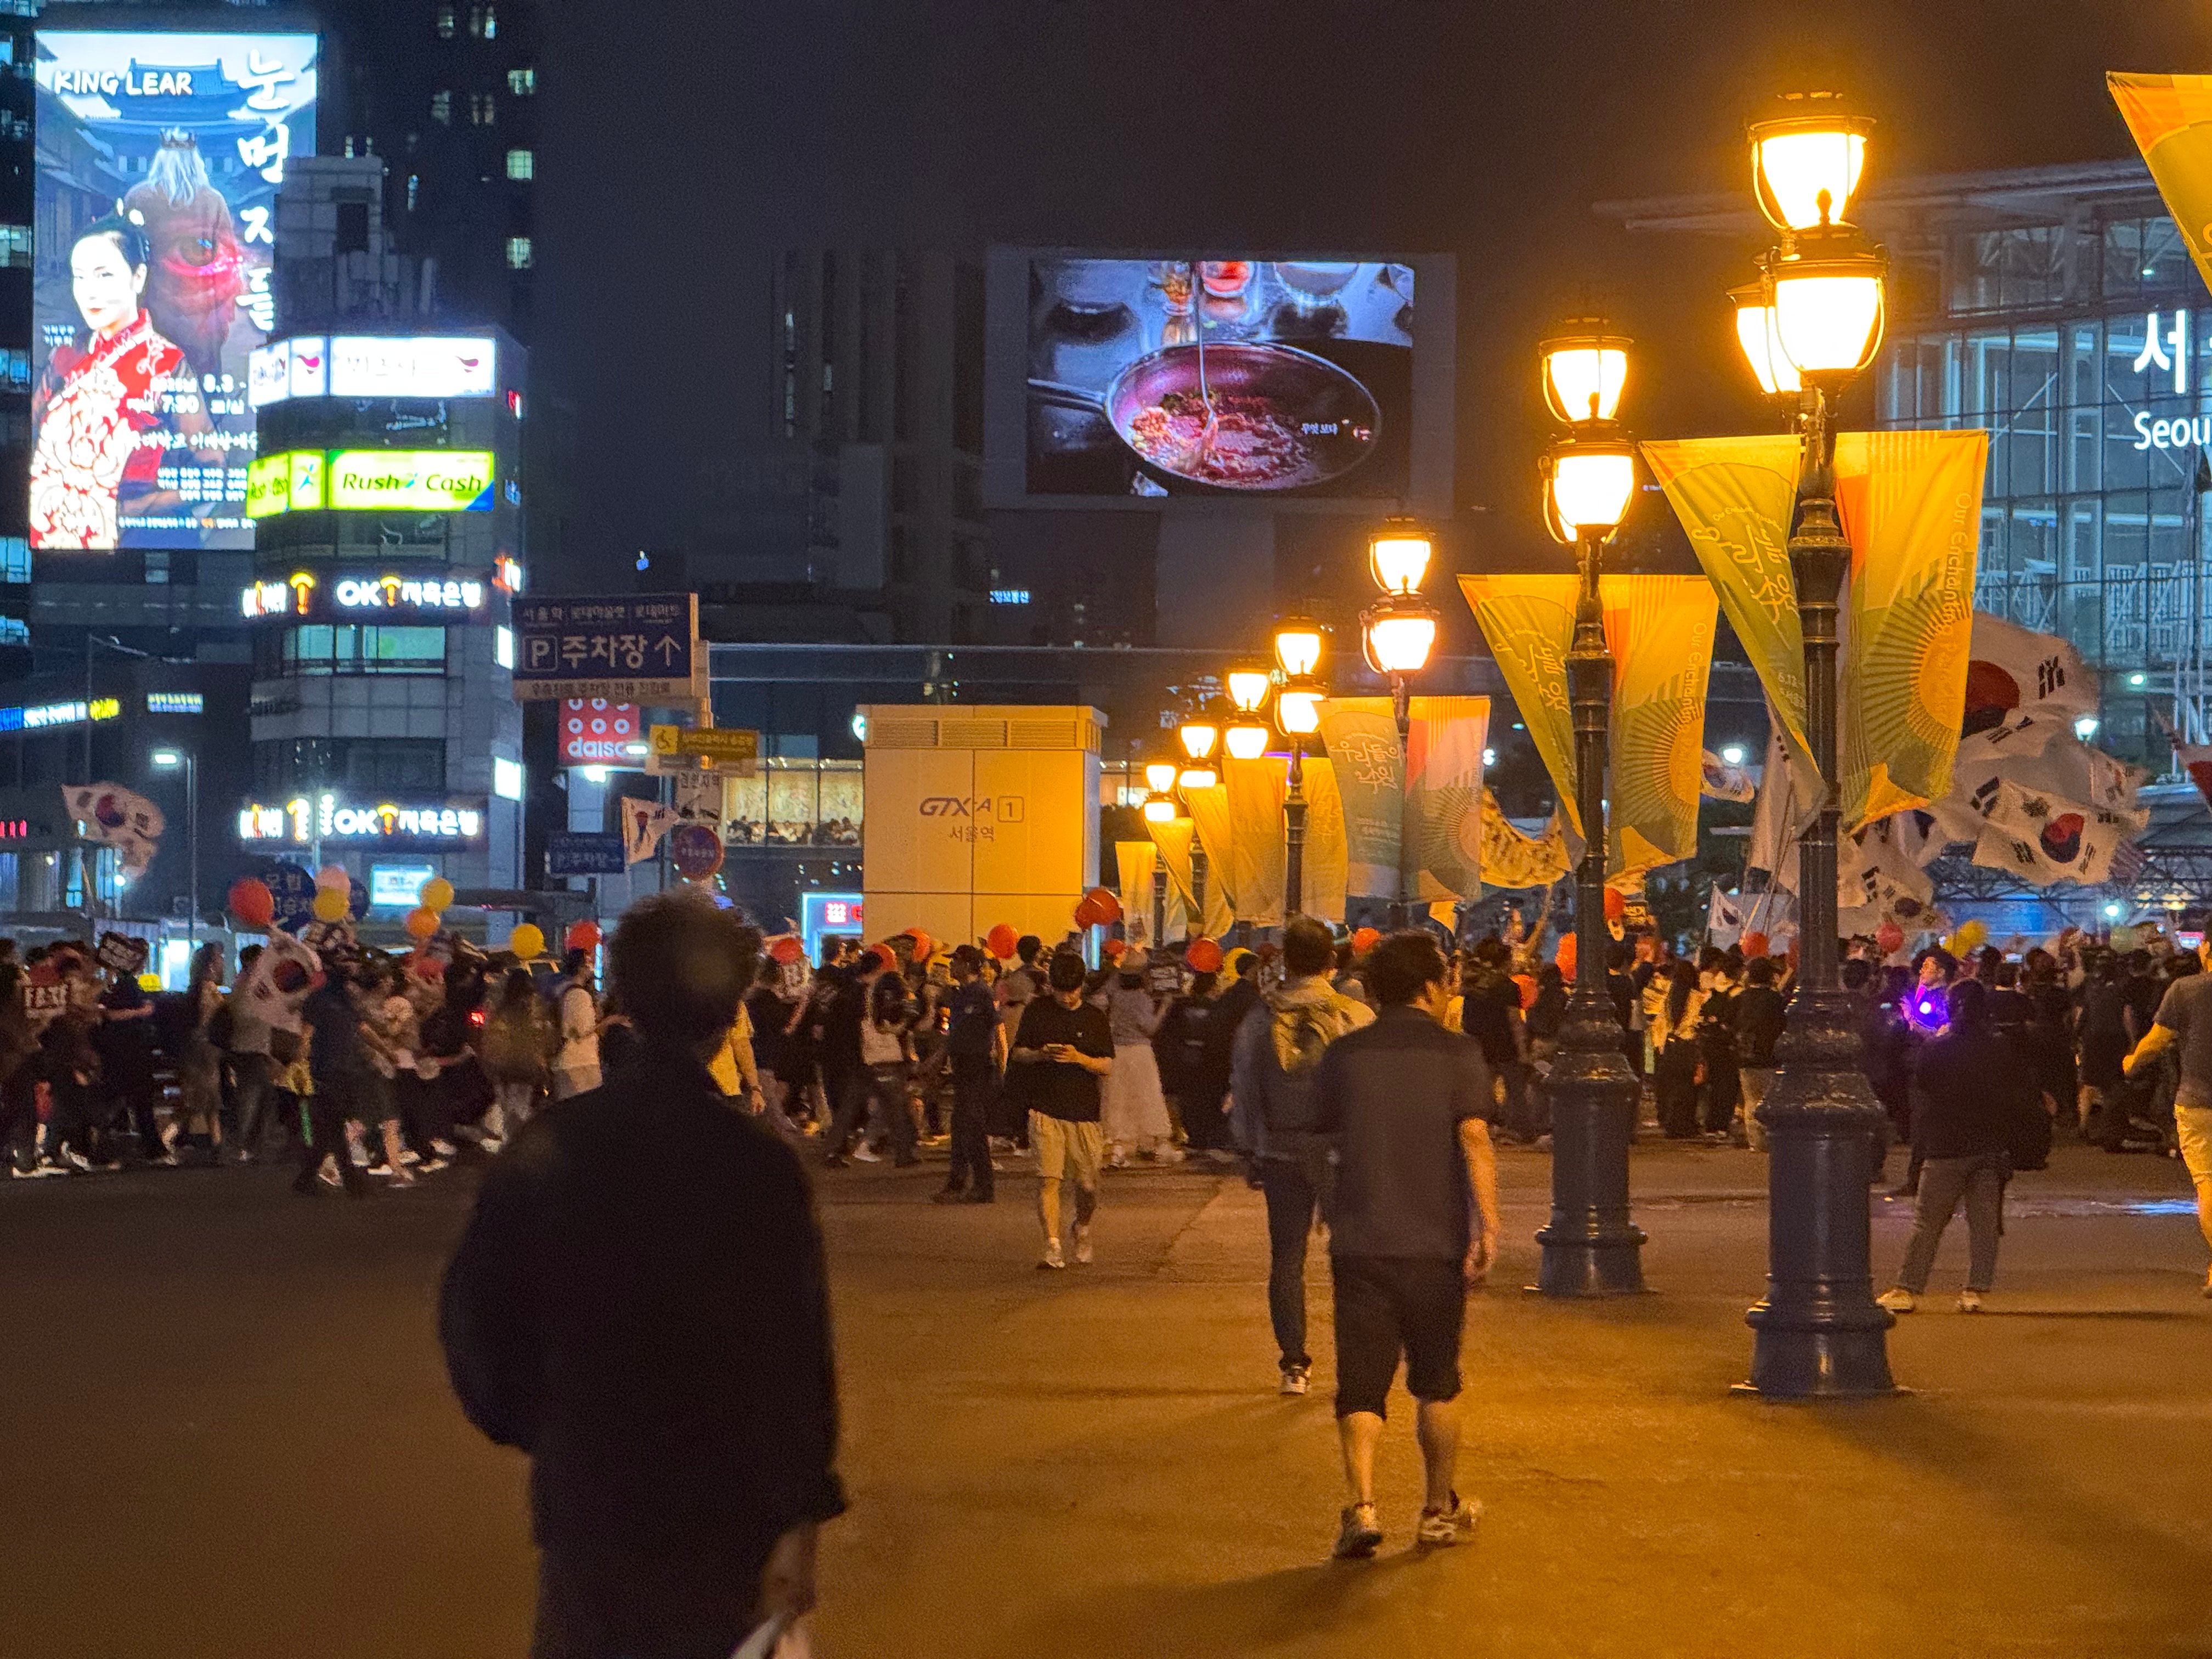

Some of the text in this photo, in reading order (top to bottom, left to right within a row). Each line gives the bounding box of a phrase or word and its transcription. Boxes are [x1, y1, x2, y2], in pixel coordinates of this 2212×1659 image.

[54, 70, 193, 95] KING LEAR
[2134, 411, 2211, 451] Seou
[343, 473, 482, 492] Rush Cash
[1954, 493, 1972, 525] Our
[336, 580, 382, 607] OK
[989, 590, 1030, 604] 정보통신
[1691, 622, 1708, 648] Our
[531, 634, 648, 669] P 주차장
[333, 809, 379, 835] OK
[948, 825, 995, 843] 서울역
